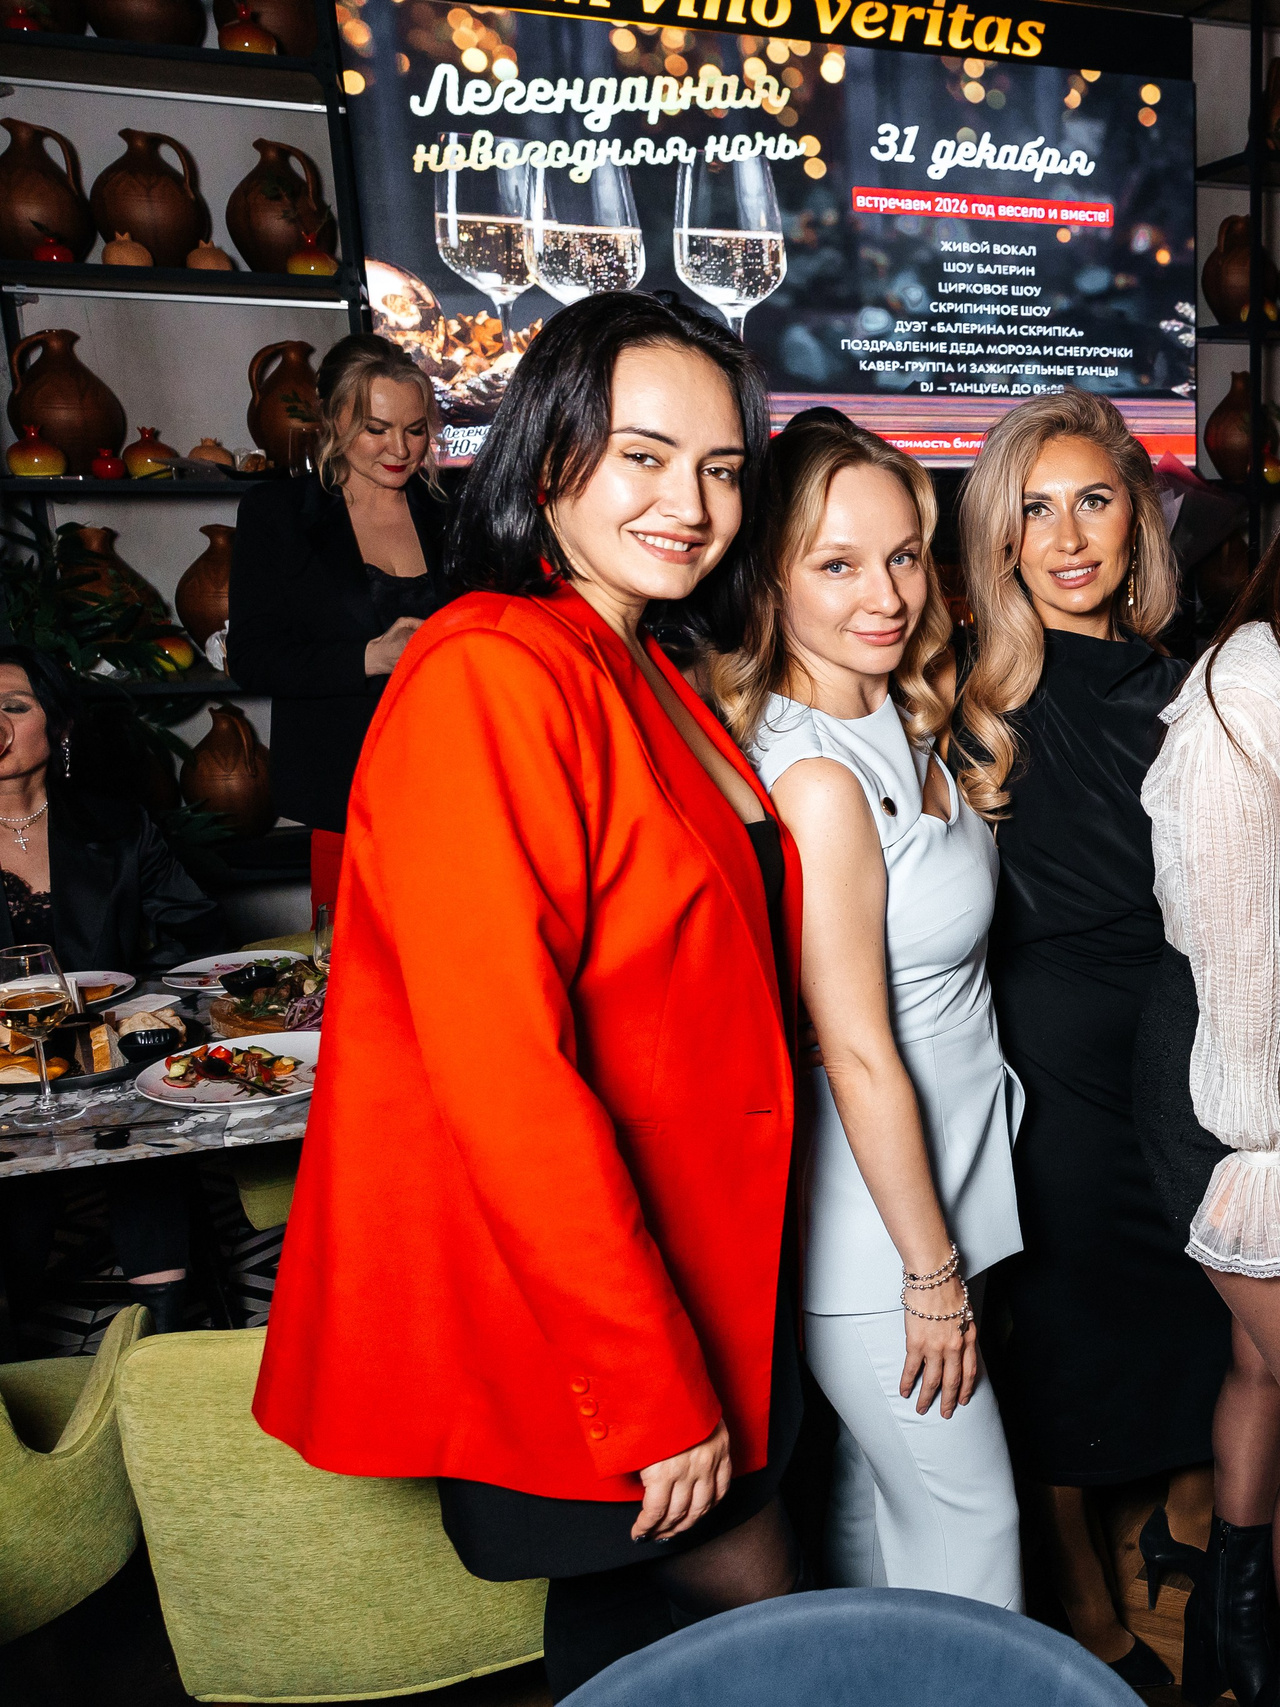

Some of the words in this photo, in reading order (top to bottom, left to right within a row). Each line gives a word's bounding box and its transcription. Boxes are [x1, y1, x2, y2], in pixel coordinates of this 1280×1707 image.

[410, 63, 790, 132] Легендарная
[412, 130, 697, 183] новогодняя
[704, 131, 807, 163] ночь
[870, 123, 919, 163] 31
[927, 132, 1095, 183] декабря
[856, 195, 931, 212] встречаем
[934, 197, 968, 214] 2026
[971, 203, 995, 217] год
[998, 204, 1045, 219] весело
[1048, 209, 1057, 220] и
[1060, 208, 1110, 223] вместе!
[940, 241, 990, 254] ЖИВОЙ
[993, 244, 1037, 256] ВОКАЛ
[943, 262, 974, 273] ШОУ
[977, 264, 1036, 276] БАЛЕРИН
[938, 282, 1009, 295] ЦИРКОВОЕ
[1011, 285, 1042, 297] ШОУ
[929, 302, 1019, 315] СКРИПИЧНОЕ
[1020, 306, 1051, 317] ШОУ
[894, 321, 928, 333] ДУЭТ
[930, 322, 1006, 335] «БАЛЕРИНА
[1007, 325, 1018, 335] И
[1020, 325, 1084, 337] СКРИПКА»
[840, 339, 948, 353] ПОЗДРАВЛЕНИЕ
[949, 342, 985, 355] ДЕДА
[986, 344, 1042, 356] МОРОЗА
[1043, 346, 1053, 356] И
[1055, 346, 1134, 358] СНЕГУРОЧКИ
[859, 361, 955, 373] КАВЕР-ГРУППА
[957, 363, 967, 373] И
[969, 363, 1075, 376] ЗАЖИГАТЕЛЬНЫЕ
[1076, 366, 1119, 378] ТАНЦЫ
[920, 382, 934, 393] DJ
[949, 382, 1009, 395] ТАНЦУЕМ
[1010, 383, 1031, 396] ДО
[886, 439, 951, 449] тоимость
